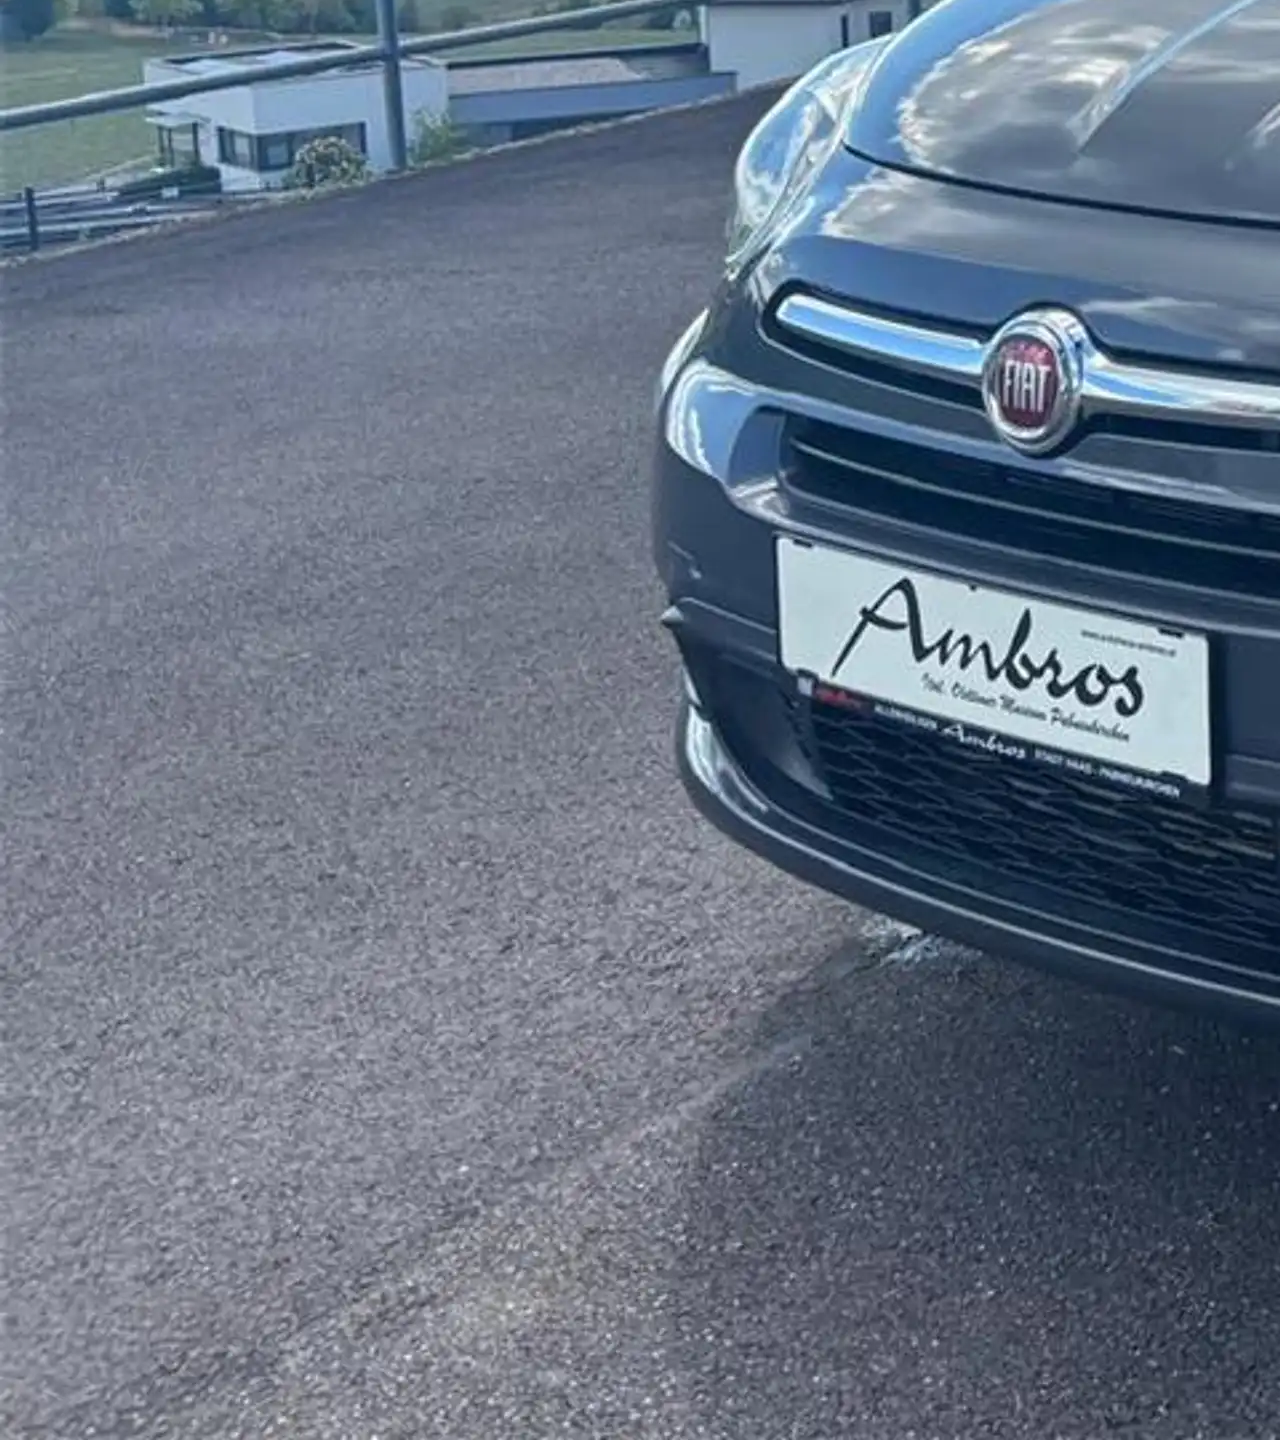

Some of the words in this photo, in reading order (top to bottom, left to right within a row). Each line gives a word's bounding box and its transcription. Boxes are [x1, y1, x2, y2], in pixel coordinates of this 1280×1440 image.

[1003, 360, 1052, 413] FIAT
[832, 577, 1143, 717] Ambros
[941, 722, 1027, 759] Ambros
